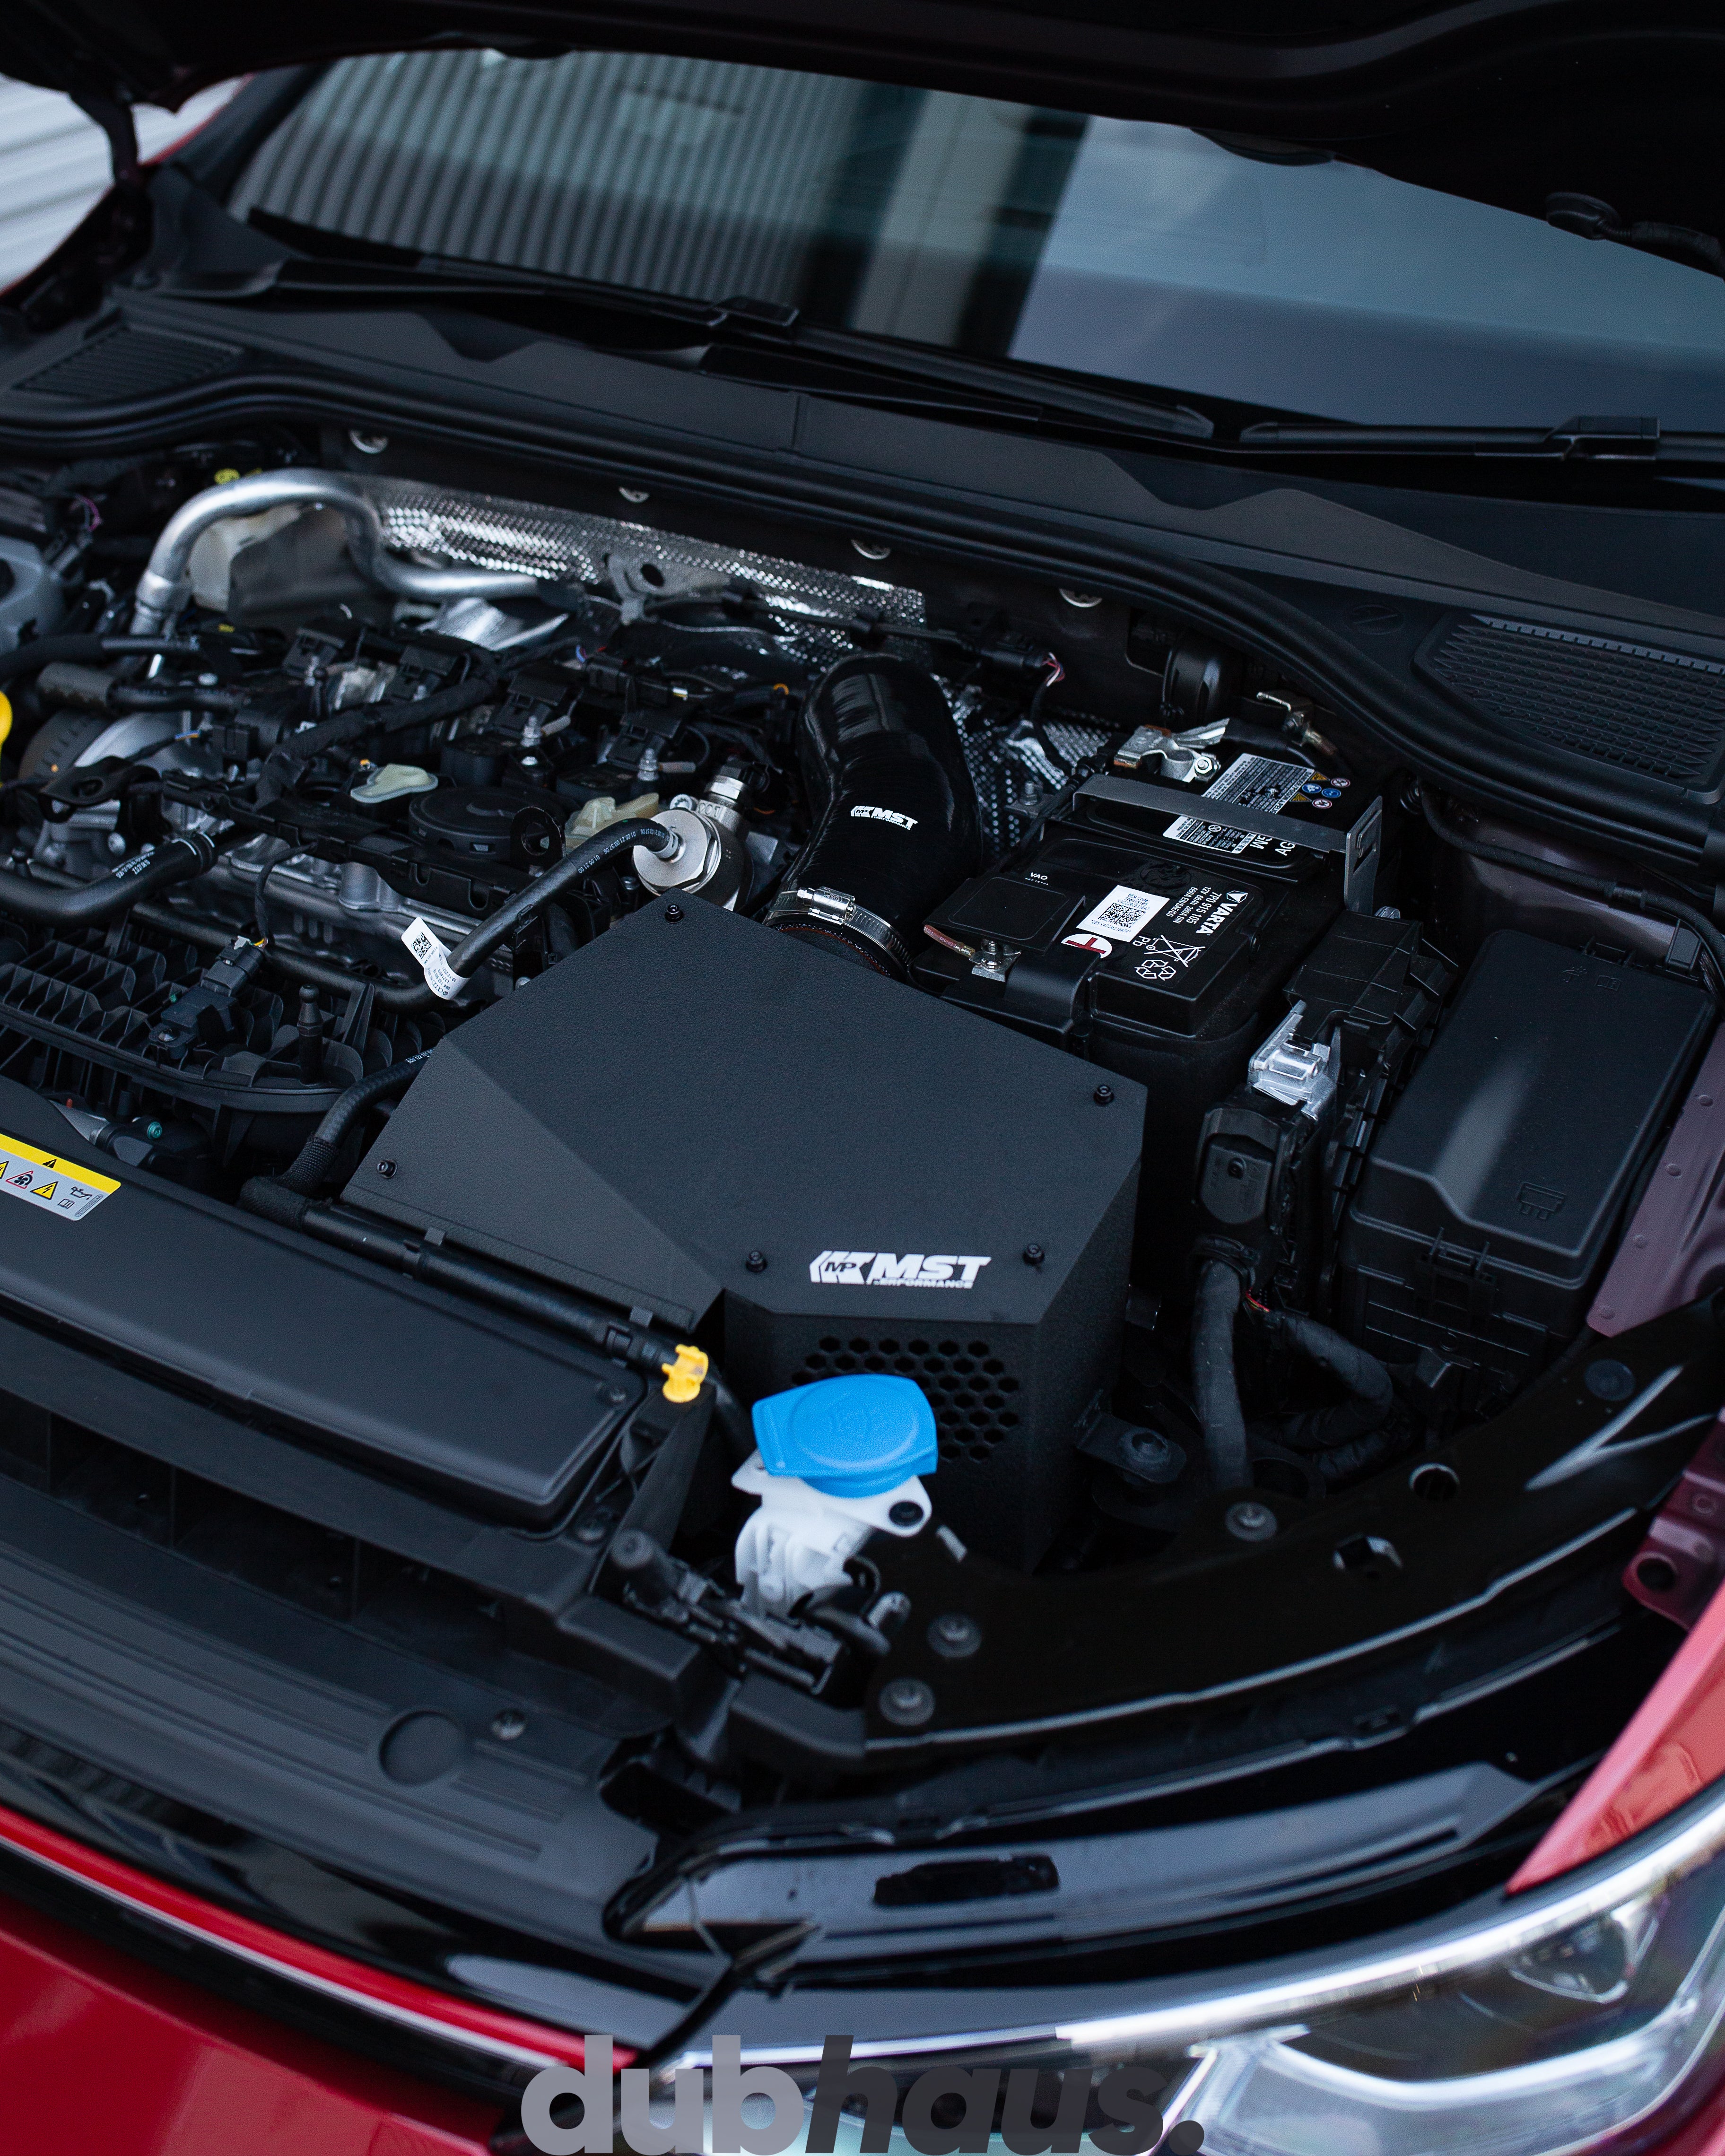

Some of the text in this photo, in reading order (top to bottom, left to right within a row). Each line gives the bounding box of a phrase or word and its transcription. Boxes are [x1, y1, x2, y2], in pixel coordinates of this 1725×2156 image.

[1275, 841, 1295, 856] AG
[1184, 887, 1198, 898] 680A
[1200, 887, 1211, 895] 12V
[1180, 905, 1194, 917] 380A
[1196, 903, 1212, 913] 915
[1186, 913, 1202, 924] 105
[1195, 903, 1238, 934] VARTA
[1133, 936, 1151, 947] Pb
[825, 1252, 992, 1281] MP MST
[872, 1277, 974, 1289] PERFORMANCE
